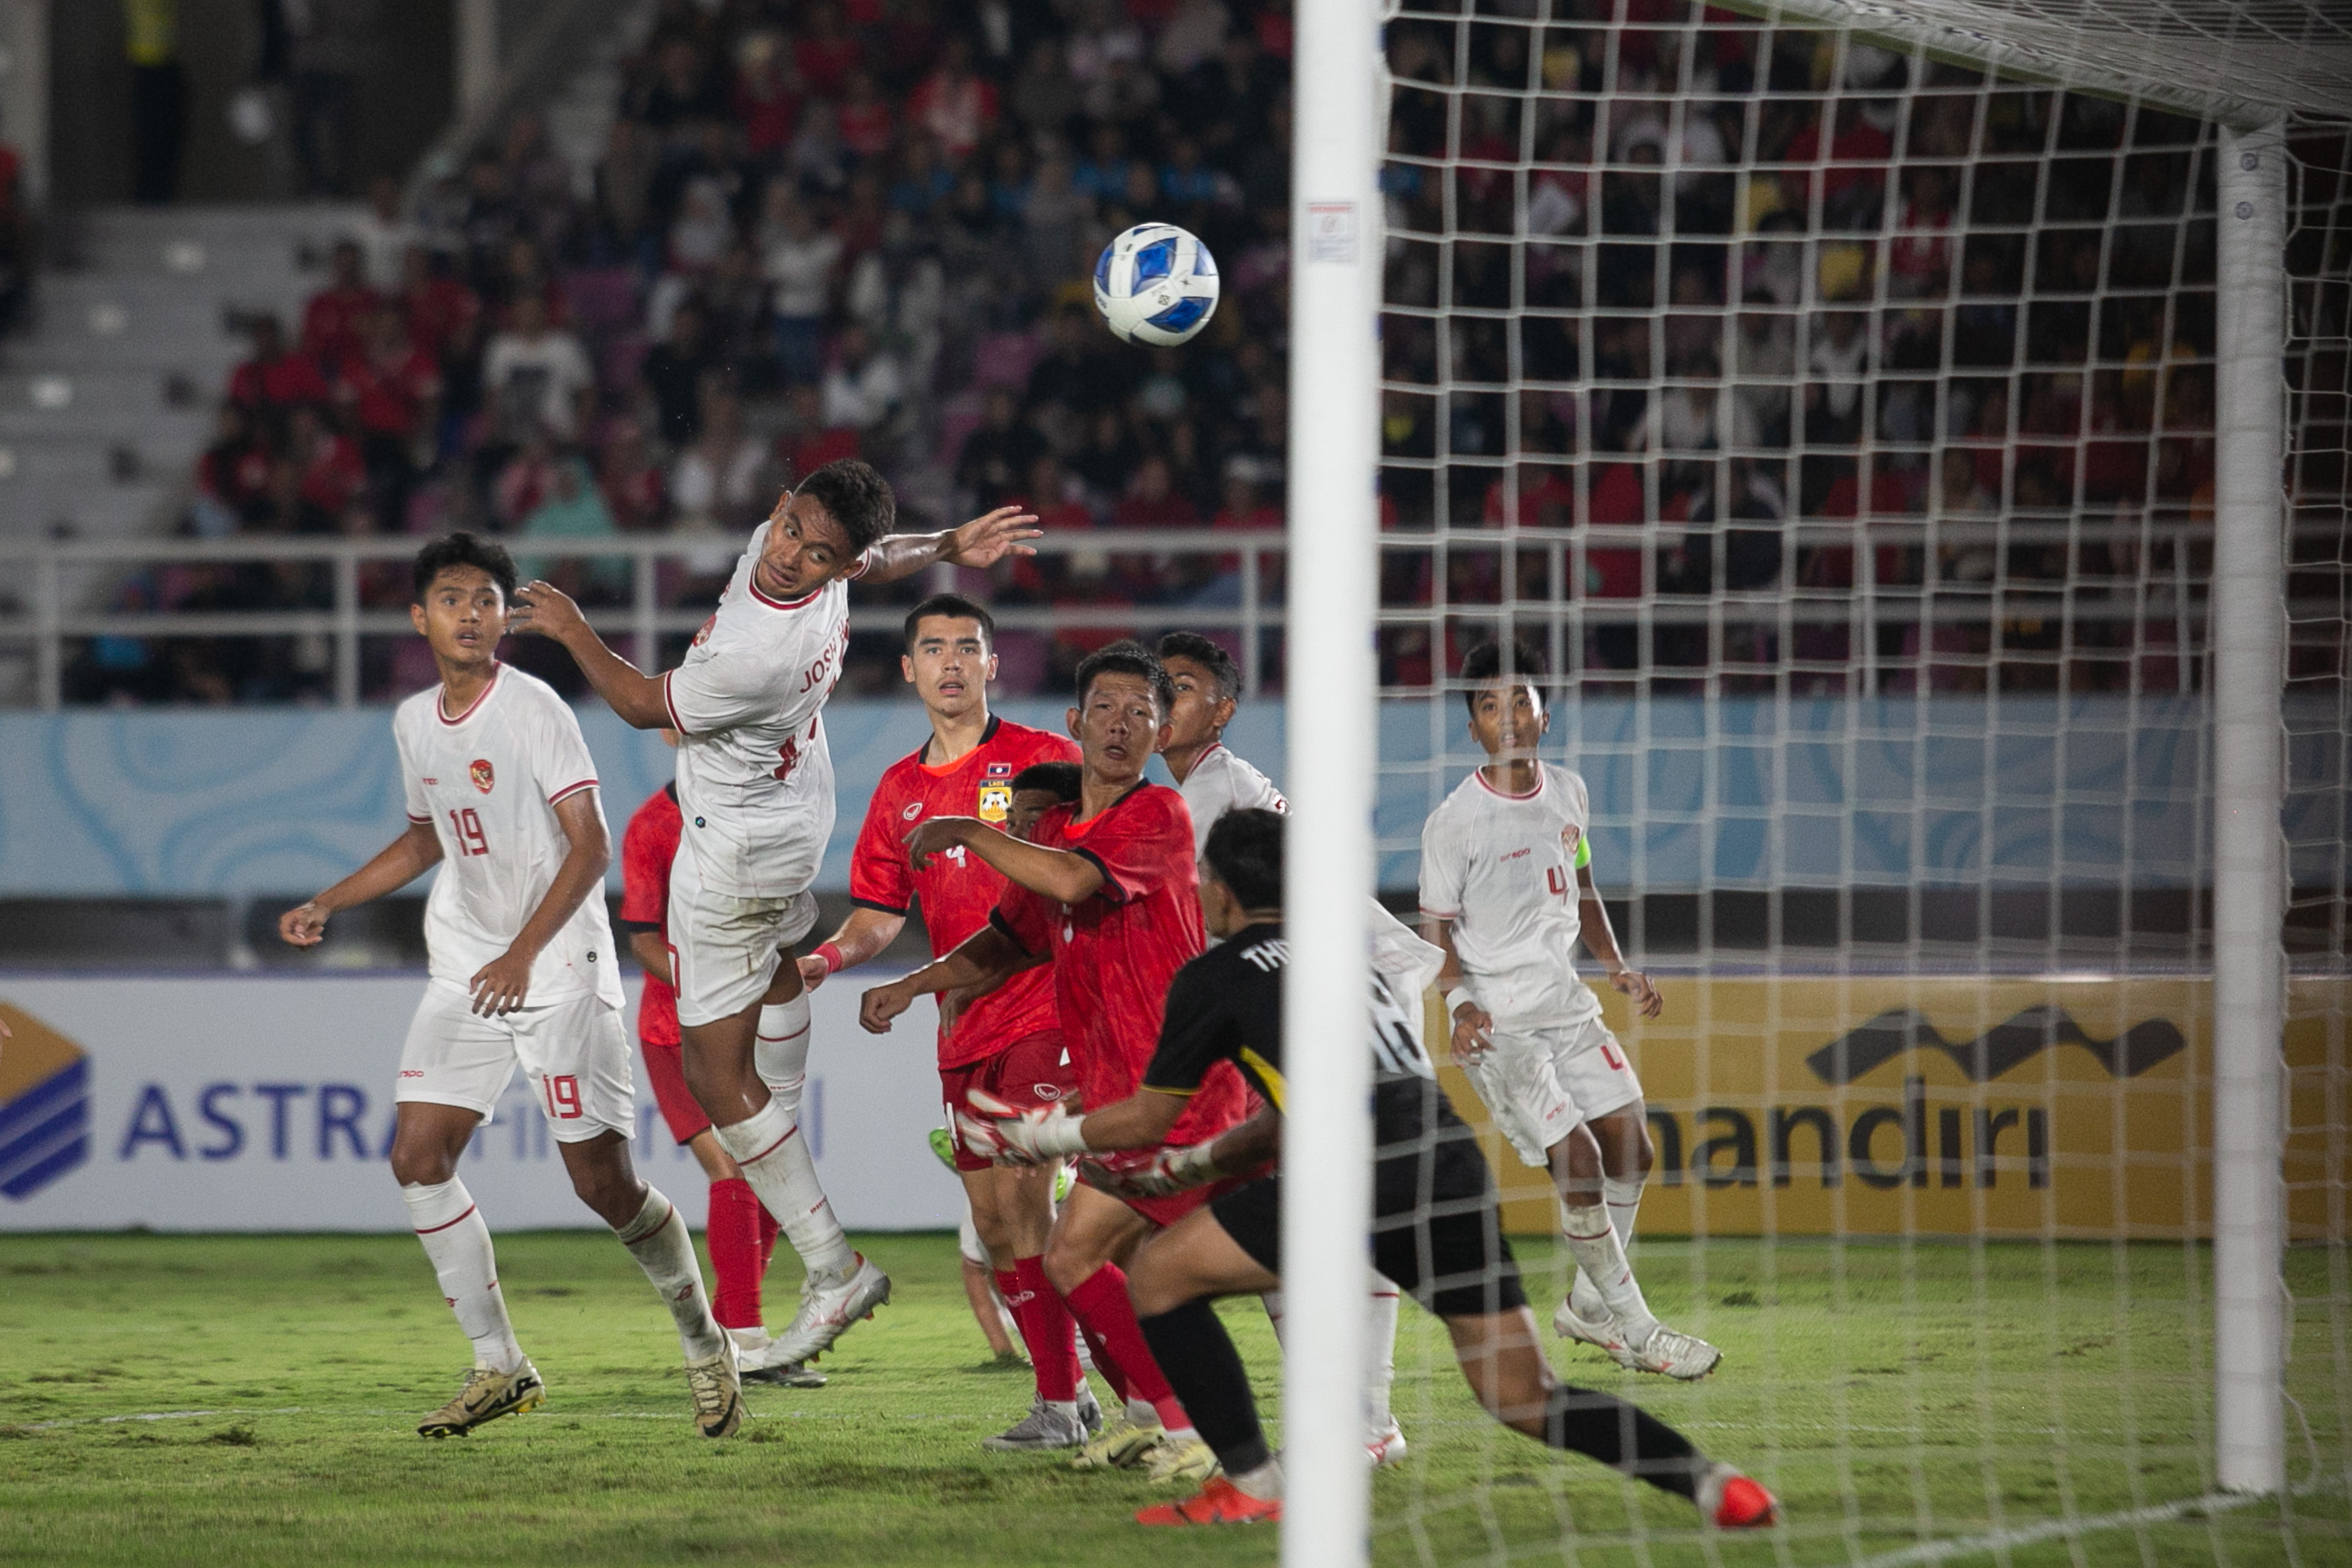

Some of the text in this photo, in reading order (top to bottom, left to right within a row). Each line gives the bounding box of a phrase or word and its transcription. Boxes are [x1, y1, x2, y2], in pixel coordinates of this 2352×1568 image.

[449, 808, 489, 856] 19
[1547, 865, 1570, 906] 4
[543, 1074, 583, 1119] 19
